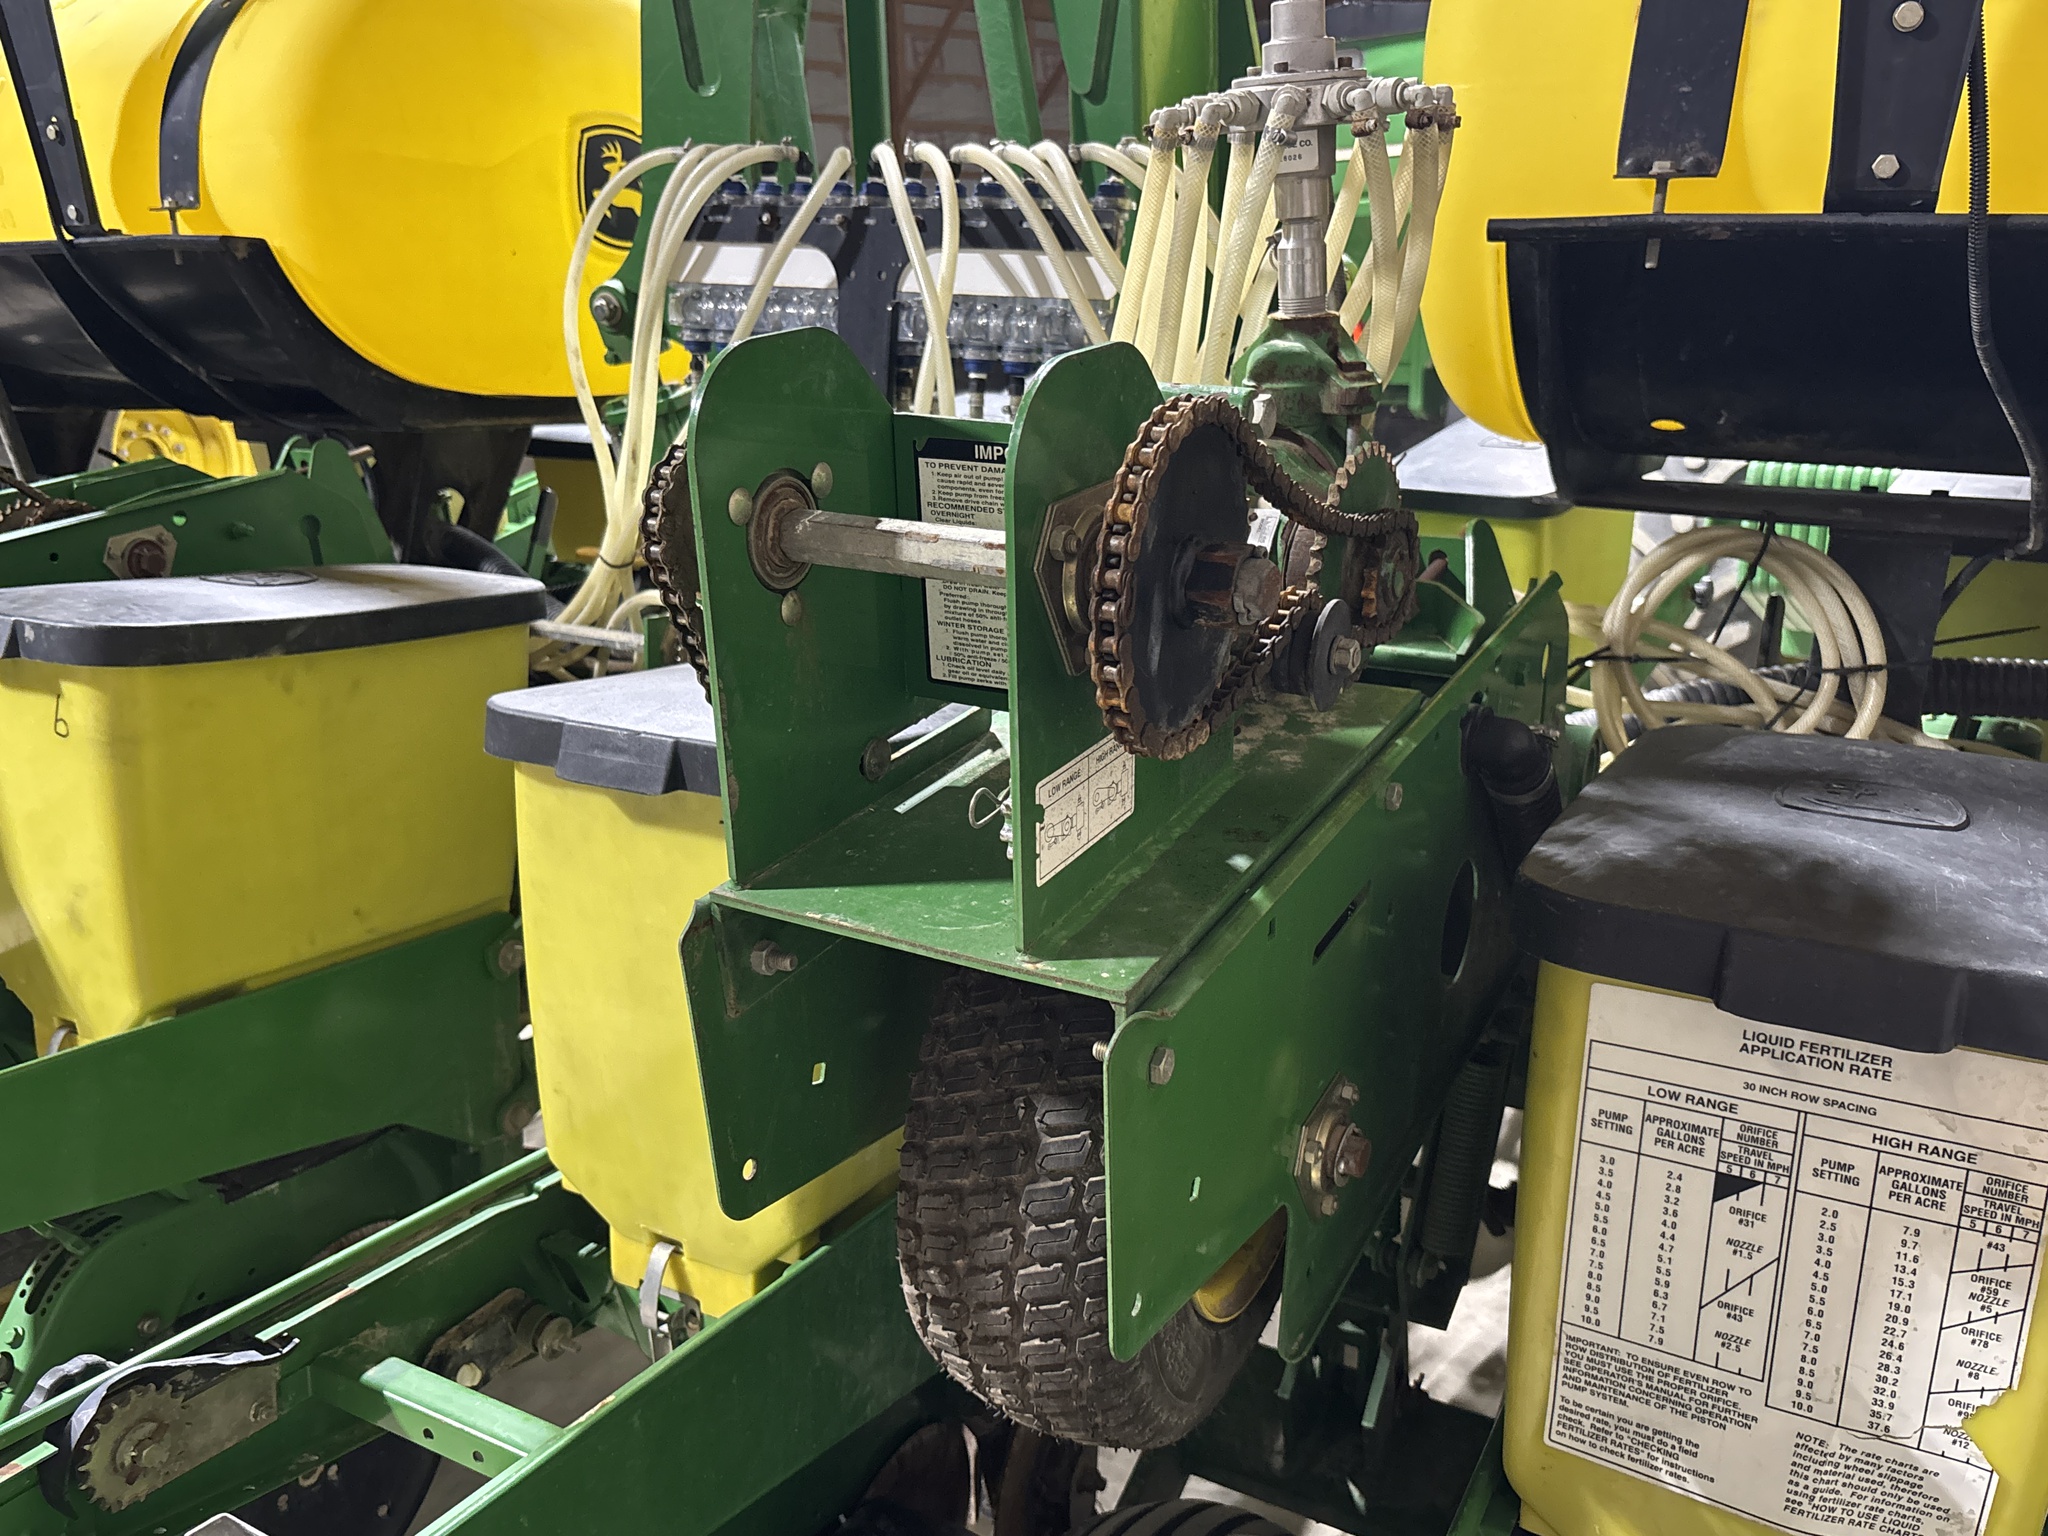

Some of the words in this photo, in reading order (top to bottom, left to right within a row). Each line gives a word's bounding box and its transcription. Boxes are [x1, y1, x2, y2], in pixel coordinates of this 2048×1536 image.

[938, 463, 978, 472] PREVENT
[927, 502, 994, 514] RECOMMENDED
[930, 510, 975, 519] OVERNIGHT
[937, 620, 965, 629] WINTER
[968, 624, 1004, 634] STORAGE
[936, 654, 991, 668] LUBRICATION
[1048, 782, 1061, 798] LOW
[1062, 769, 1081, 788] RANGE
[1742, 1029, 1795, 1049] LIQUID
[1799, 1040, 1893, 1068] FERTILIZER
[1739, 1043, 1844, 1073] APPLICATION
[1849, 1064, 1892, 1082] RATE
[1647, 1086, 1681, 1102] LOW
[1685, 1093, 1739, 1115] RANGE
[1743, 1082, 1756, 1091] 30
[1759, 1085, 1788, 1098] INCH
[1790, 1091, 1820, 1104] ROW
[1823, 1098, 1877, 1116] SPACING
[1598, 1109, 1628, 1122] PUMP
[1591, 1118, 1633, 1135] SETTING
[1644, 1114, 1720, 1139] APPROXIMATE
[1739, 1124, 1778, 1140] ORIFICE
[1656, 1127, 1705, 1146] GALLONS
[1736, 1132, 1778, 1149] NUMBER
[1654, 1137, 1675, 1150] PER
[1677, 1143, 1706, 1157] ACRE
[1872, 1133, 1913, 1152] HIGH
[1917, 1143, 1978, 1165] RANGE
[1600, 1154, 1615, 1166] 3.0
[1738, 1146, 1774, 1162] TRAVEL
[1720, 1151, 1751, 1165] SPEED
[1754, 1159, 1764, 1168] IN
[1766, 1161, 1791, 1174] MPH
[1726, 1164, 1733, 1173] 5
[1820, 1158, 1855, 1173] PUMP
[1598, 1166, 1614, 1178] 3.5
[1667, 1170, 1682, 1182] 2.4
[1749, 1170, 1756, 1179] 6
[1812, 1167, 1860, 1187] SETTING
[1597, 1179, 1613, 1189] 4.0
[1775, 1175, 1781, 1184] 7
[1878, 1165, 1964, 1192] APPROXIMATE
[1665, 1182, 1681, 1194] 2.8
[1891, 1179, 1946, 1200] GALLONS
[1986, 1177, 2029, 1194] ORIFICE
[1596, 1190, 1611, 1201] 4.5
[1664, 1194, 1680, 1206] 3.2
[1982, 1185, 2029, 1204] NUMBER
[1888, 1190, 1912, 1204] PER
[1914, 1196, 1947, 1212] ACRE
[1595, 1202, 1610, 1213] 5.0
[1662, 1206, 1678, 1218] 3.6
[1984, 1199, 2023, 1216] TRAVEL
[1593, 1213, 1608, 1224] 5.5
[1729, 1206, 1767, 1223] ORIFICE
[1963, 1205, 1998, 1220] SPEED
[2000, 1213, 2012, 1223] IN
[2015, 1215, 2040, 1229] MPH
[1661, 1219, 1677, 1230] 4.0
[1738, 1218, 1754, 1229] #31
[1969, 1219, 1976, 1229] 5
[1592, 1225, 1607, 1236] 6.0
[1903, 1226, 1921, 1238] 7.9
[1995, 1225, 2002, 1235] 6
[2023, 1230, 2030, 1240] 7
[1591, 1236, 1606, 1248] 6.5
[1660, 1231, 1675, 1242] 4.4
[1658, 1243, 1674, 1253] 4.7
[1726, 1238, 1764, 1254] NOZZLE
[1901, 1239, 1918, 1250] 9.7
[1986, 1241, 2006, 1252] #43
[1590, 1248, 1605, 1259] 7.0
[1657, 1254, 1672, 1265] 5.1
[1732, 1248, 1753, 1260] #1.5
[1896, 1251, 1919, 1264] 11.6
[1589, 1259, 1604, 1270] 7.5
[1894, 1264, 1917, 1277] 13.4
[1587, 1270, 1602, 1282] 8.0
[1656, 1266, 1671, 1277] 5.5
[1586, 1282, 1601, 1293] 8.5
[1654, 1277, 1670, 1289] 5.9
[1892, 1276, 1915, 1289] 15.3
[1970, 1274, 2012, 1290] ORIFICE
[1653, 1289, 1669, 1300] 6.3
[1890, 1289, 1912, 1302] 17.1
[1980, 1286, 1999, 1297] #59
[1585, 1293, 1600, 1304] 9.0
[1968, 1292, 2010, 1308] NOZZLE
[1584, 1304, 1599, 1315] 9.5
[1652, 1300, 1667, 1311] 6.7
[1717, 1300, 1754, 1318] ORIFICE
[1888, 1301, 1911, 1314] 19.0
[1980, 1304, 1992, 1314] #5
[1581, 1315, 1600, 1327] 10.0
[1651, 1312, 1665, 1323] 7.1
[1726, 1312, 1743, 1323] #43
[1885, 1313, 1909, 1326] 20.9
[1650, 1323, 1665, 1334] 7.5
[1883, 1326, 1907, 1338] 22.7
[1961, 1326, 2002, 1343] ORIFICE
[1649, 1334, 1664, 1346] 7.9
[1714, 1330, 1752, 1347] NOZZLE
[1881, 1338, 1905, 1351] 24.6
[1970, 1338, 1989, 1349] #78
[1720, 1341, 1741, 1353] #2.5
[1879, 1350, 1902, 1363] 26.4
[1565, 1334, 1621, 1356] IMPORTANT:
[1626, 1352, 1639, 1362] TO
[1641, 1357, 1681, 1375] ENSURE
[1683, 1370, 1710, 1384] EVEN
[1711, 1379, 1736, 1392] ROW
[1738, 1386, 1752, 1396] TO
[1565, 1342, 1587, 1354] ROW
[1589, 1349, 1655, 1375] DISTRIBUTION
[1657, 1370, 1670, 1379] OF
[1673, 1375, 1729, 1398] FERTILIZER
[1877, 1362, 1901, 1375] 28.3
[1956, 1359, 1997, 1375] NOZZLE
[1875, 1374, 1899, 1387] 30.2
[1968, 1371, 1980, 1380] #8
[1561, 1380, 1588, 1393] PUMP
[1589, 1389, 1629, 1408] SYSTEM.
[1873, 1386, 1897, 1399] 32.0
[1871, 1397, 1895, 1411] 33.9
[1869, 1409, 1893, 1422] 35.7
[1867, 1421, 1890, 1434] 37.6
[1952, 1439, 1970, 1450] #12
[1796, 1432, 1829, 1449] NOTE:
[1839, 1443, 1858, 1454] The
[1860, 1451, 1882, 1461] rate
[1884, 1458, 1919, 1472] charts
[1922, 1469, 1940, 1477] are
